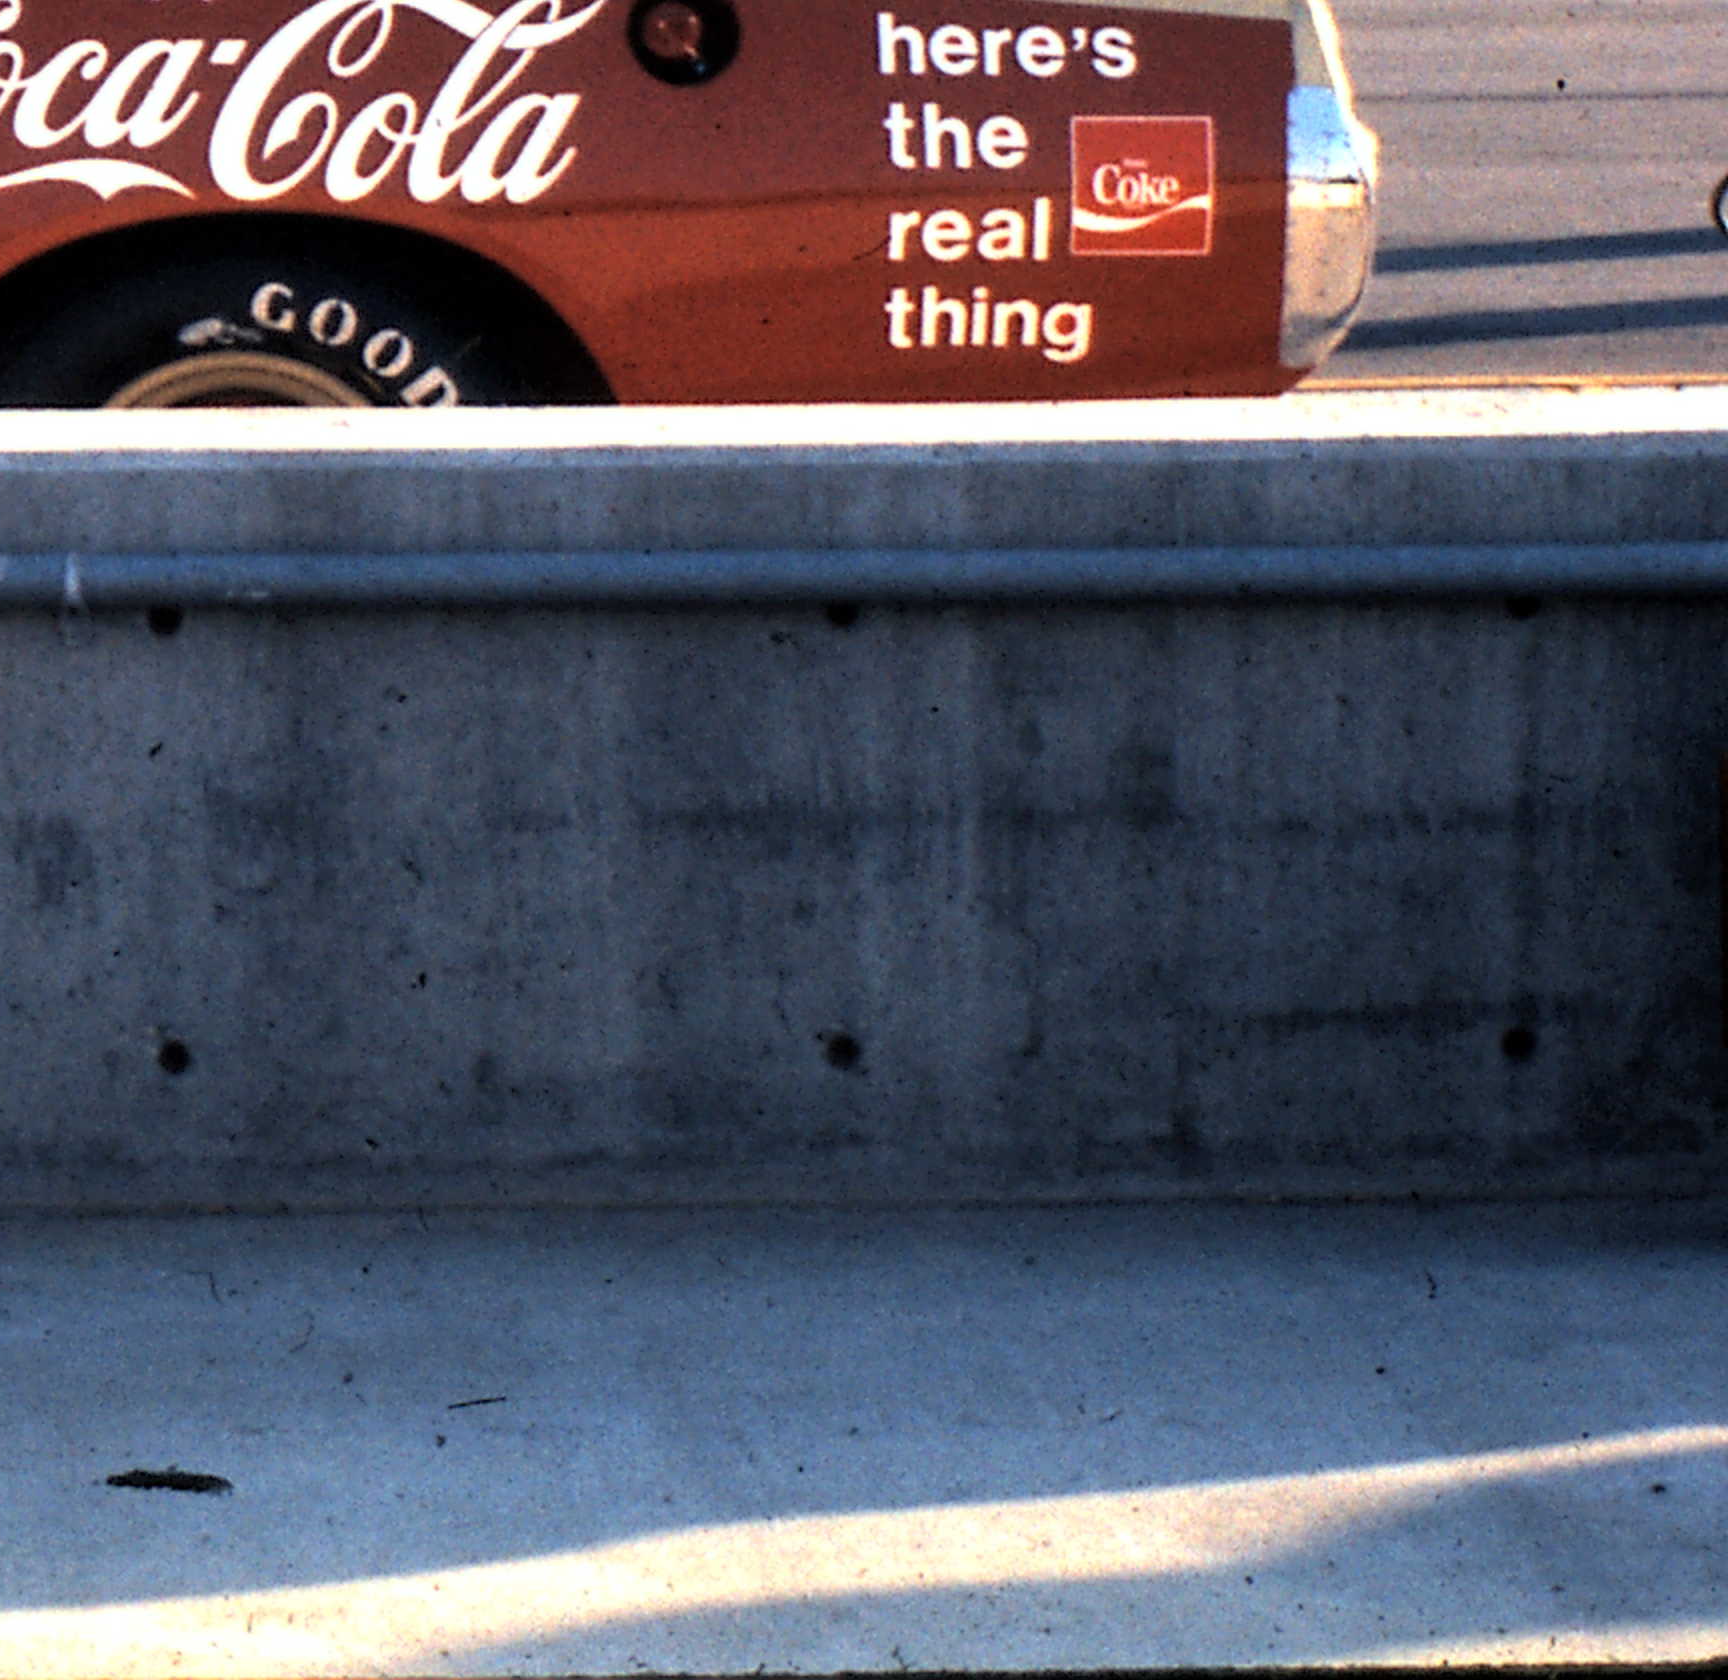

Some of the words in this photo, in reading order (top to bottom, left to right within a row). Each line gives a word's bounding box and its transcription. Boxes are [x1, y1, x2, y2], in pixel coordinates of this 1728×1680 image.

[876, 11, 1138, 78] here's
[884, 102, 1029, 169] the
[1092, 163, 1181, 208] Coke
[888, 196, 1051, 261] real
[884, 286, 1094, 363] thing
